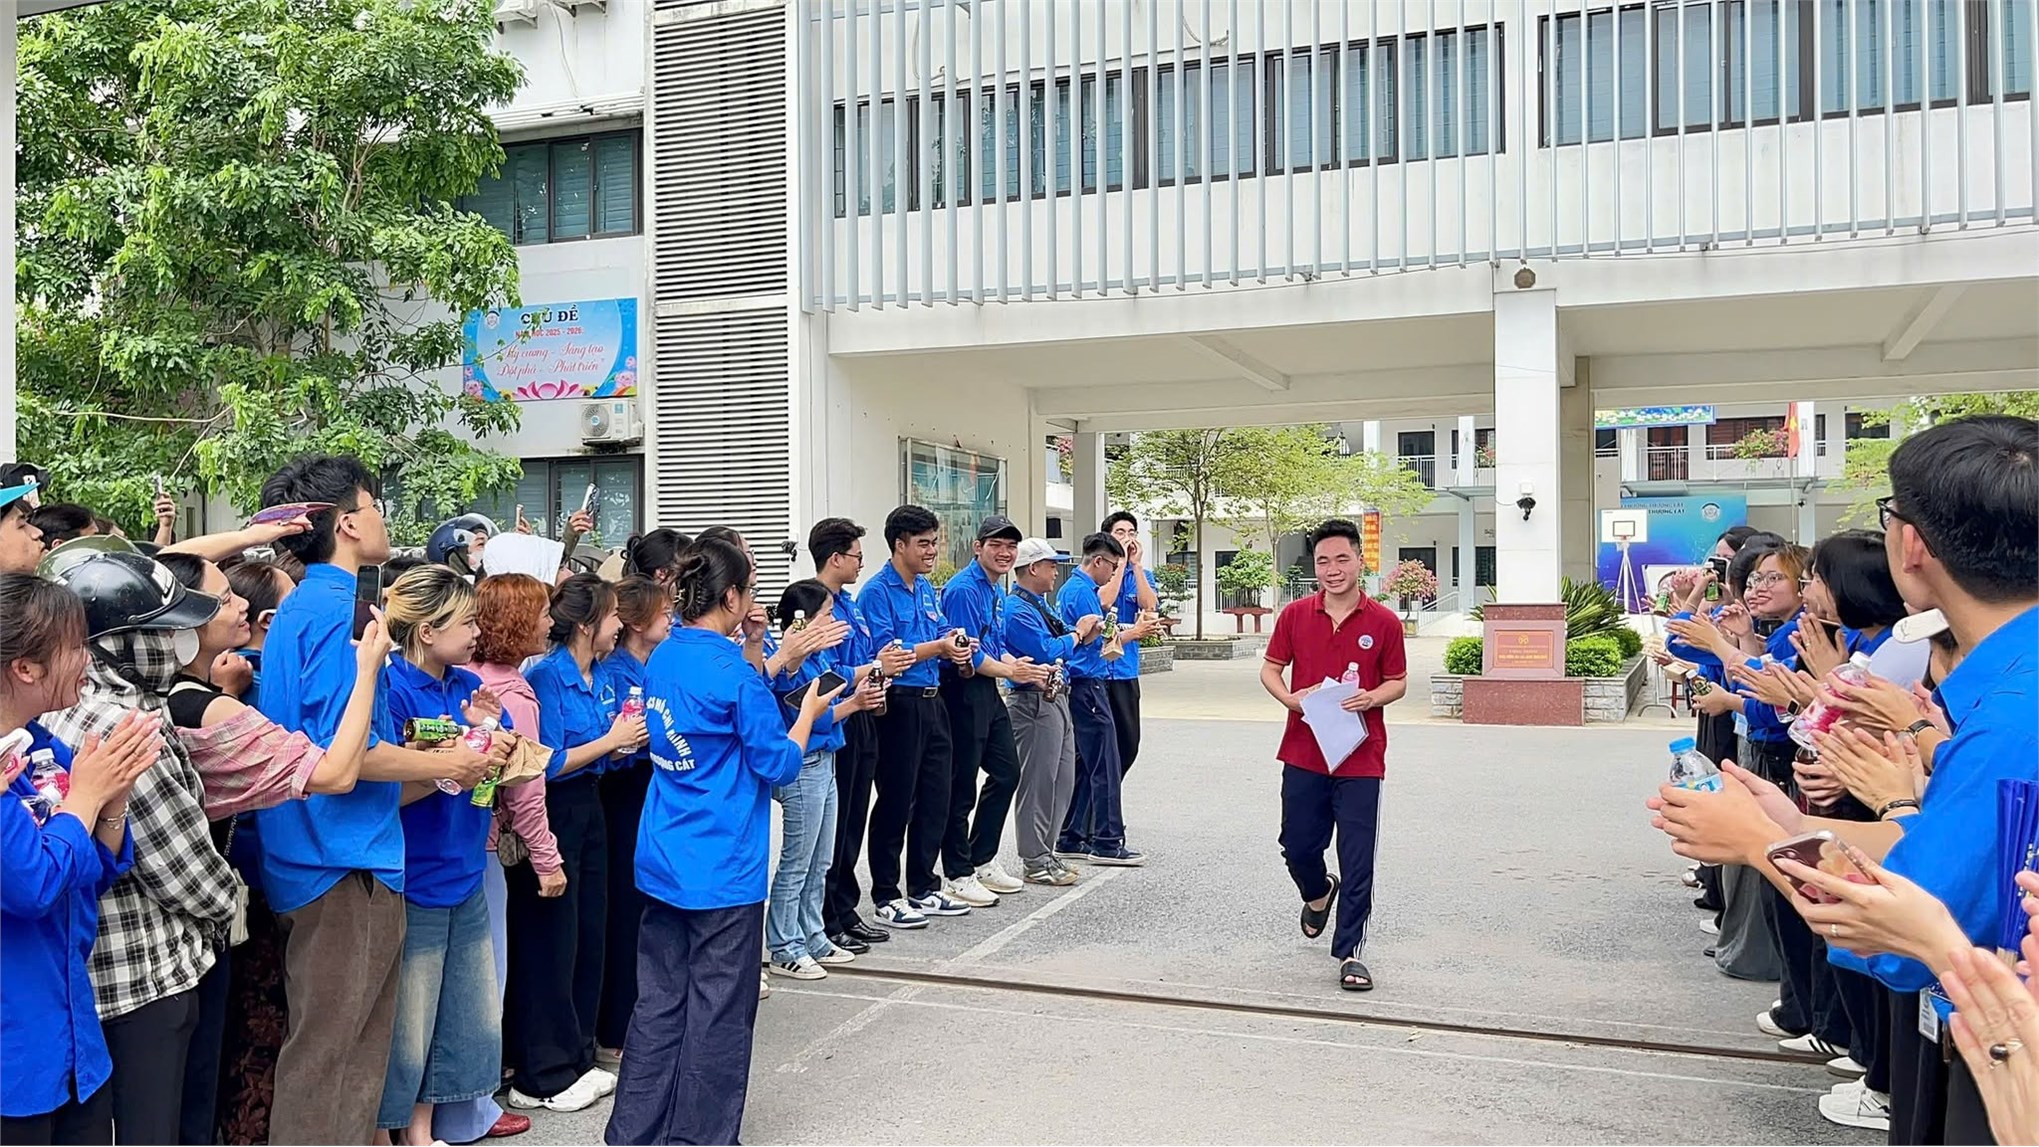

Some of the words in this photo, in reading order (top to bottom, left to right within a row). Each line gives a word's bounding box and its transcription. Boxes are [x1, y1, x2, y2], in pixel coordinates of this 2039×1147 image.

[521, 308, 552, 324] CỦ
[557, 304, 579, 322] ĐỀ
[545, 328, 560, 337] 2025
[666, 728, 692, 757] MINH
[675, 758, 695, 771] CÁT
